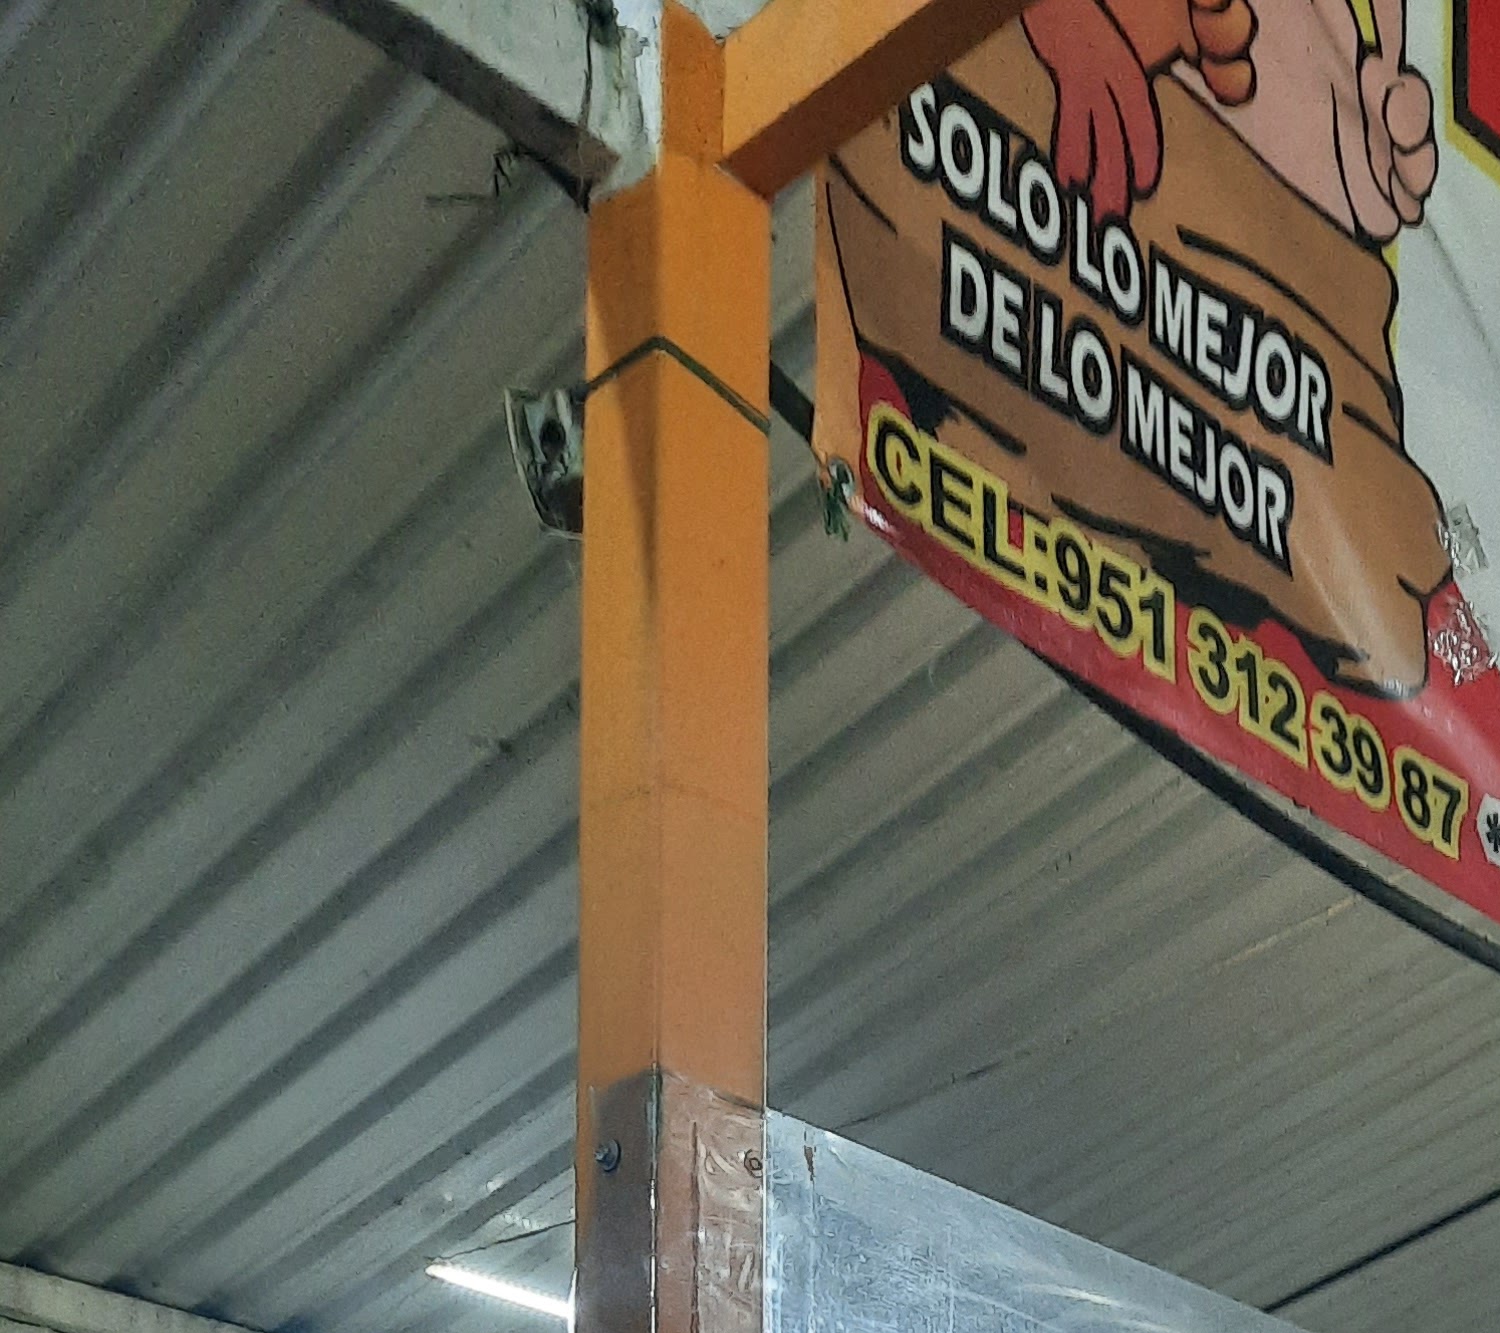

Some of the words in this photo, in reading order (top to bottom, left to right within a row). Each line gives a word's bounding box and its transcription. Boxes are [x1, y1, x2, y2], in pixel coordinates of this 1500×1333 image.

[902, 82, 1062, 253] SOLO
[1071, 198, 1143, 318] LO
[1150, 255, 1332, 446] MEJOR
[946, 250, 1029, 366] DE
[1037, 298, 1113, 421] LO
[1126, 376, 1290, 558] MEJOR
[872, 412, 1172, 668] CEL:951
[1194, 615, 1305, 754] 312
[1317, 704, 1388, 802] 39
[1400, 754, 1466, 850] 87
